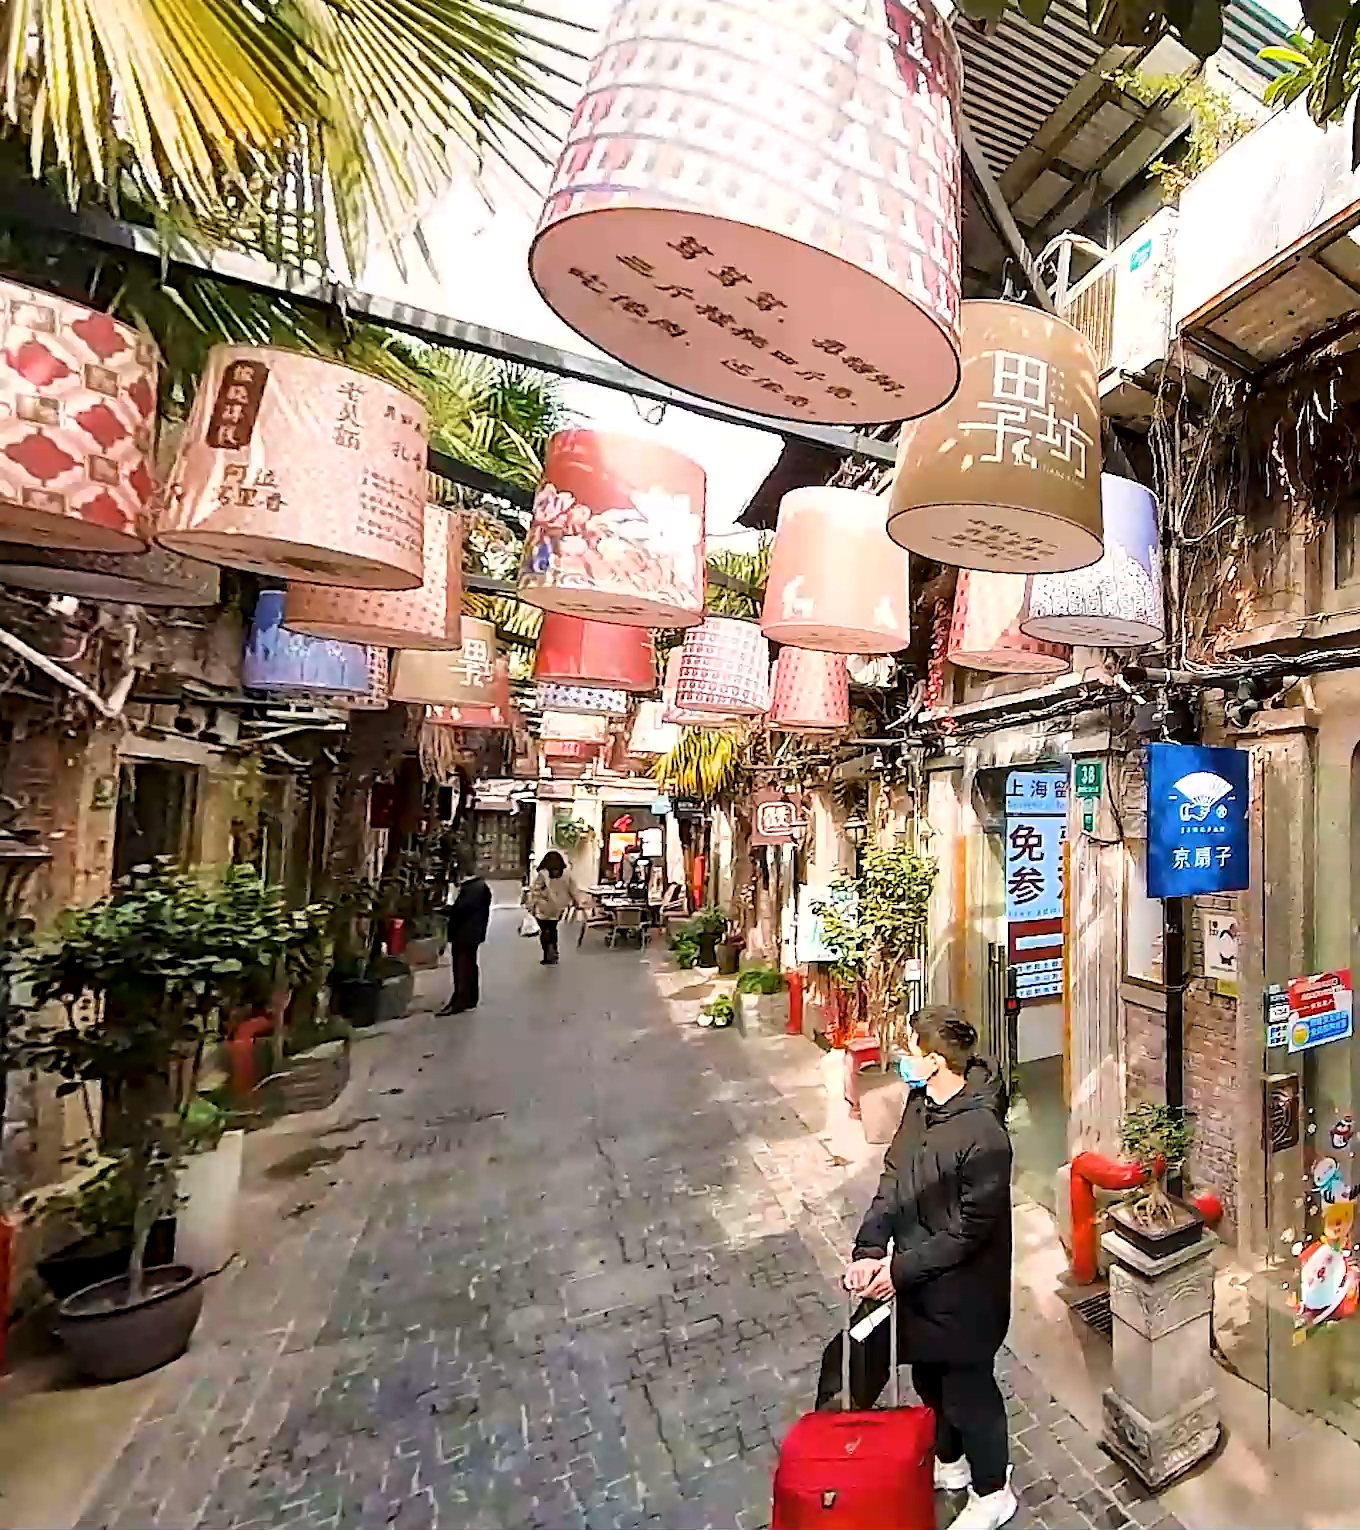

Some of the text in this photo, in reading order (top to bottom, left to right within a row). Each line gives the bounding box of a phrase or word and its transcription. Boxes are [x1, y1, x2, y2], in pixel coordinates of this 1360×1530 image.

[957, 349, 1094, 480] 田子坊
[1080, 765, 1096, 785] 38
[1171, 845, 1233, 870] 京扇子
